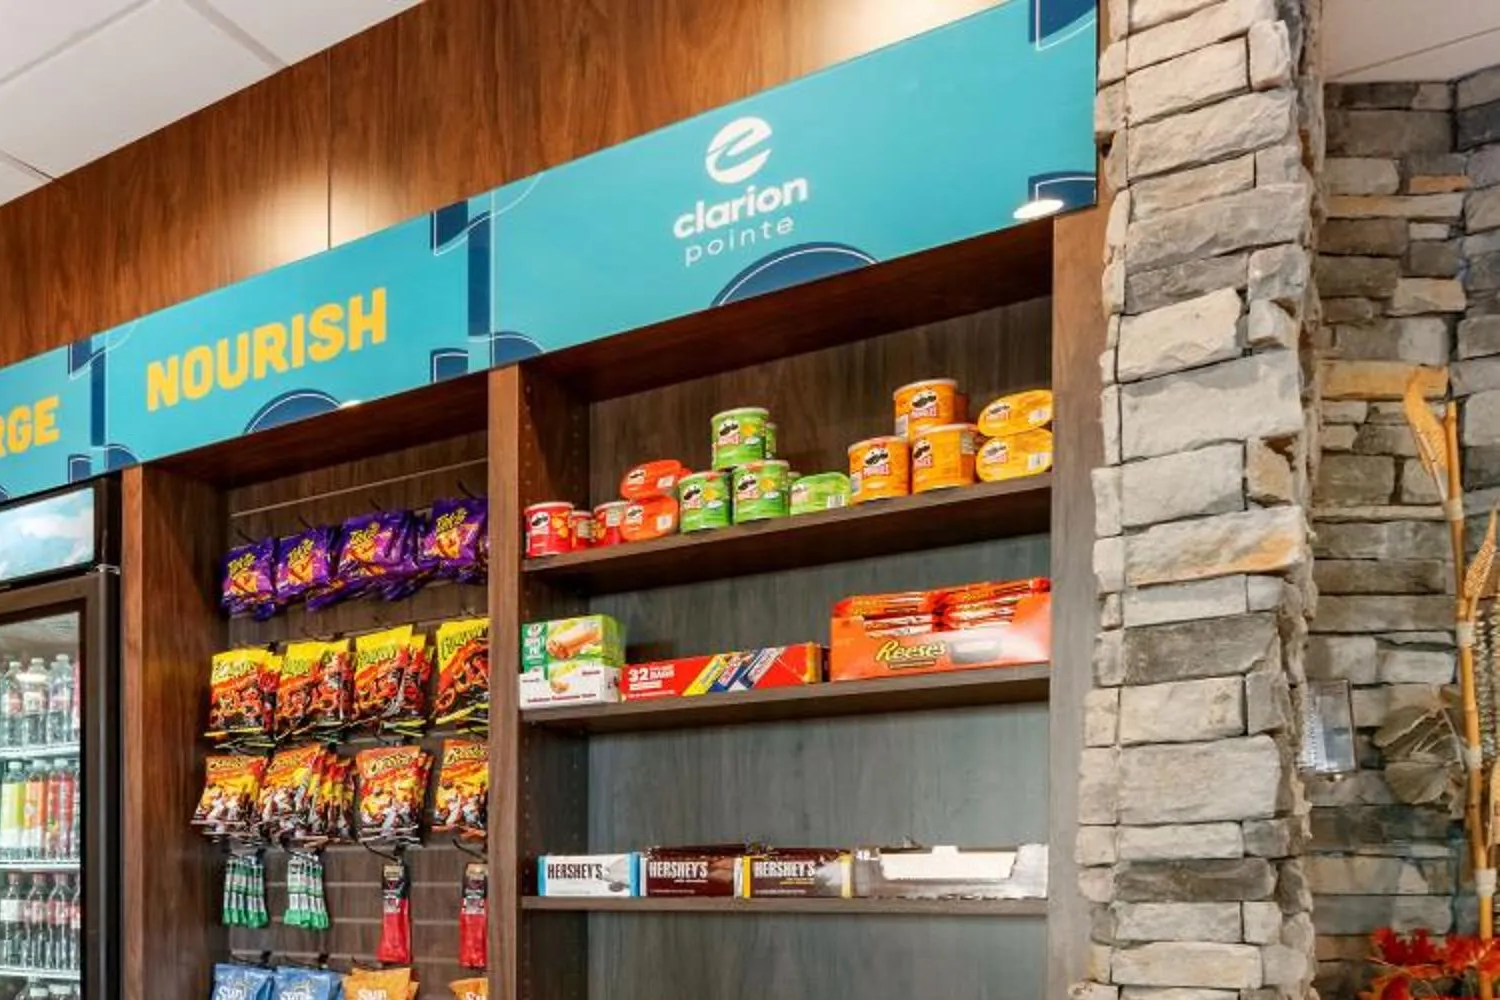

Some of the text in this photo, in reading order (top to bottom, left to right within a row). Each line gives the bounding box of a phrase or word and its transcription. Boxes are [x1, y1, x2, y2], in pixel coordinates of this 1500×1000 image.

[673, 177, 808, 239] clarion
[685, 216, 794, 267] pointe
[146, 287, 387, 411] NOURISH
[628, 667, 650, 682] 32
[547, 862, 603, 881] HERSHEY'S
[649, 861, 709, 879] HERSHEY'S
[753, 861, 816, 878] HERSHEY'S
